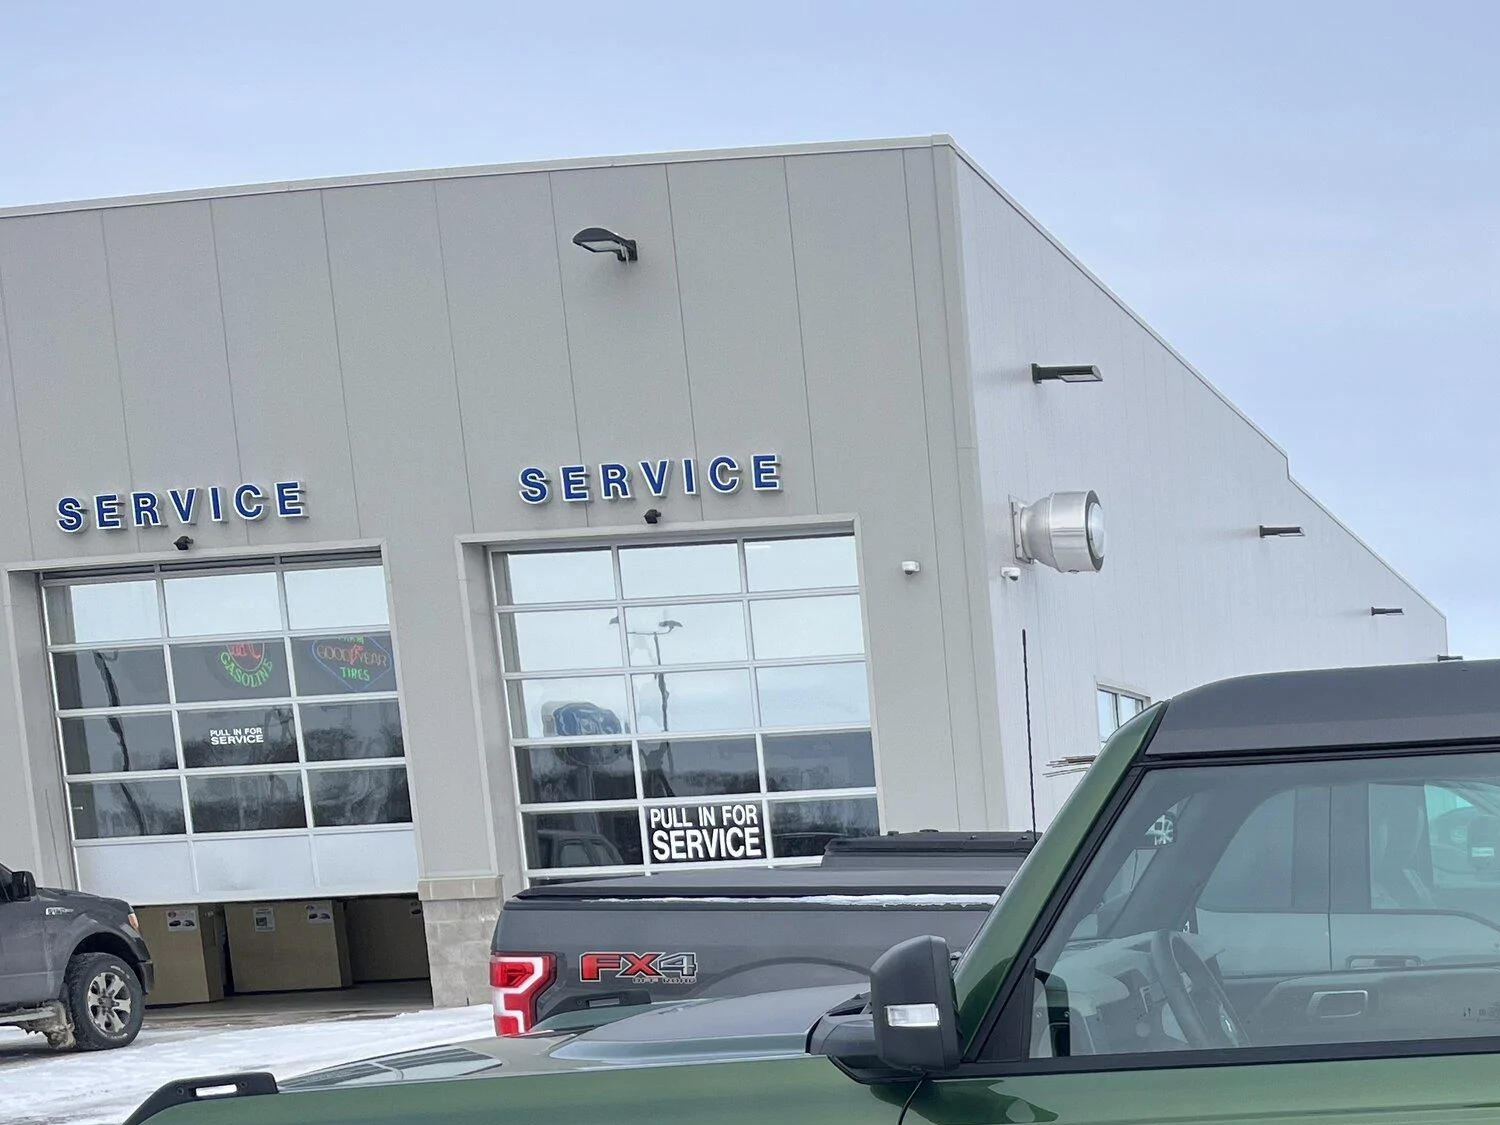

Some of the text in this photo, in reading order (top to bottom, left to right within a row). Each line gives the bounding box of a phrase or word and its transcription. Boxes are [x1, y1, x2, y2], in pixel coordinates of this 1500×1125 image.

[518, 453, 782, 504] SERVICE
[57, 480, 305, 533] SERVICE
[220, 651, 273, 688] GASOLINE
[340, 667, 370, 682] TIRES
[209, 729, 230, 737] PULL
[245, 727, 263, 735] FOR
[210, 734, 264, 746] SERVICE
[650, 804, 758, 829] PULL IN FOR
[652, 826, 762, 860] SERVICE
[580, 951, 698, 982] FX4
